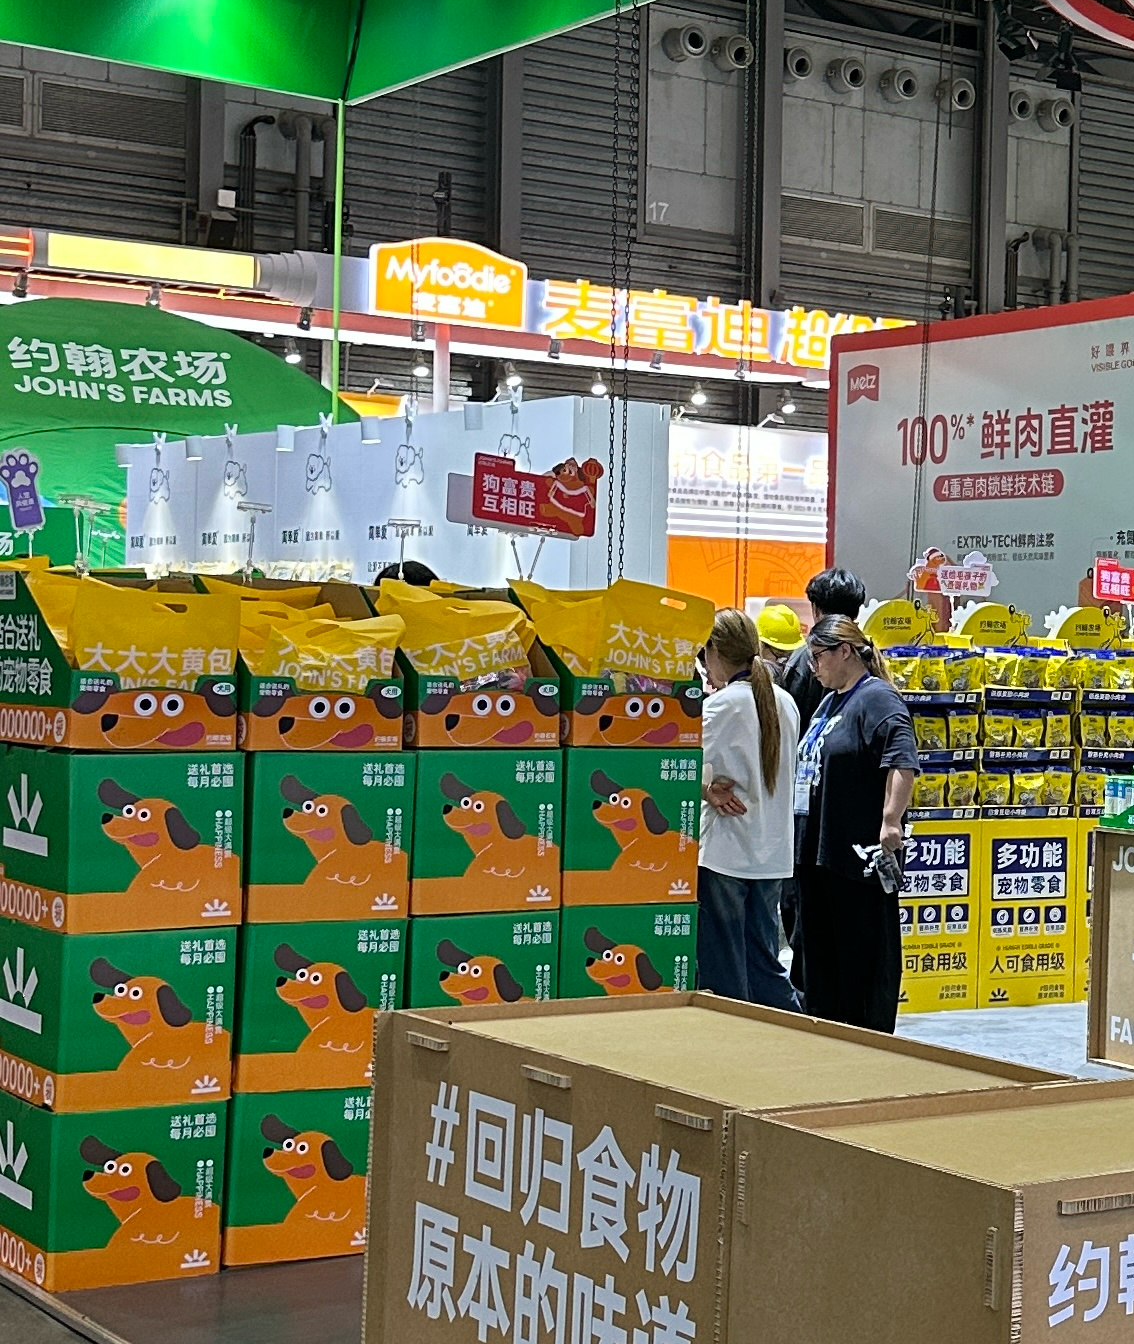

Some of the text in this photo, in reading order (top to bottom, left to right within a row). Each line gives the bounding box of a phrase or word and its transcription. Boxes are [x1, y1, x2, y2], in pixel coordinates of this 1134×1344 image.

[648, 201, 670, 222] 17
[385, 255, 512, 295] Myfoodie
[14, 374, 233, 407] JOHN'S FARMS
[850, 373, 876, 392] Metz
[980, 400, 1115, 461] 鲜肉直灌
[482, 473, 536, 500] 狗富贵
[481, 493, 536, 520] 互相旺
[996, 841, 1063, 870] 多功能
[996, 874, 1062, 897] 宠物零食
[903, 952, 968, 974] 可食用级
[989, 952, 1066, 974] 人可食用级
[425, 1080, 701, 1283] #回归食物
